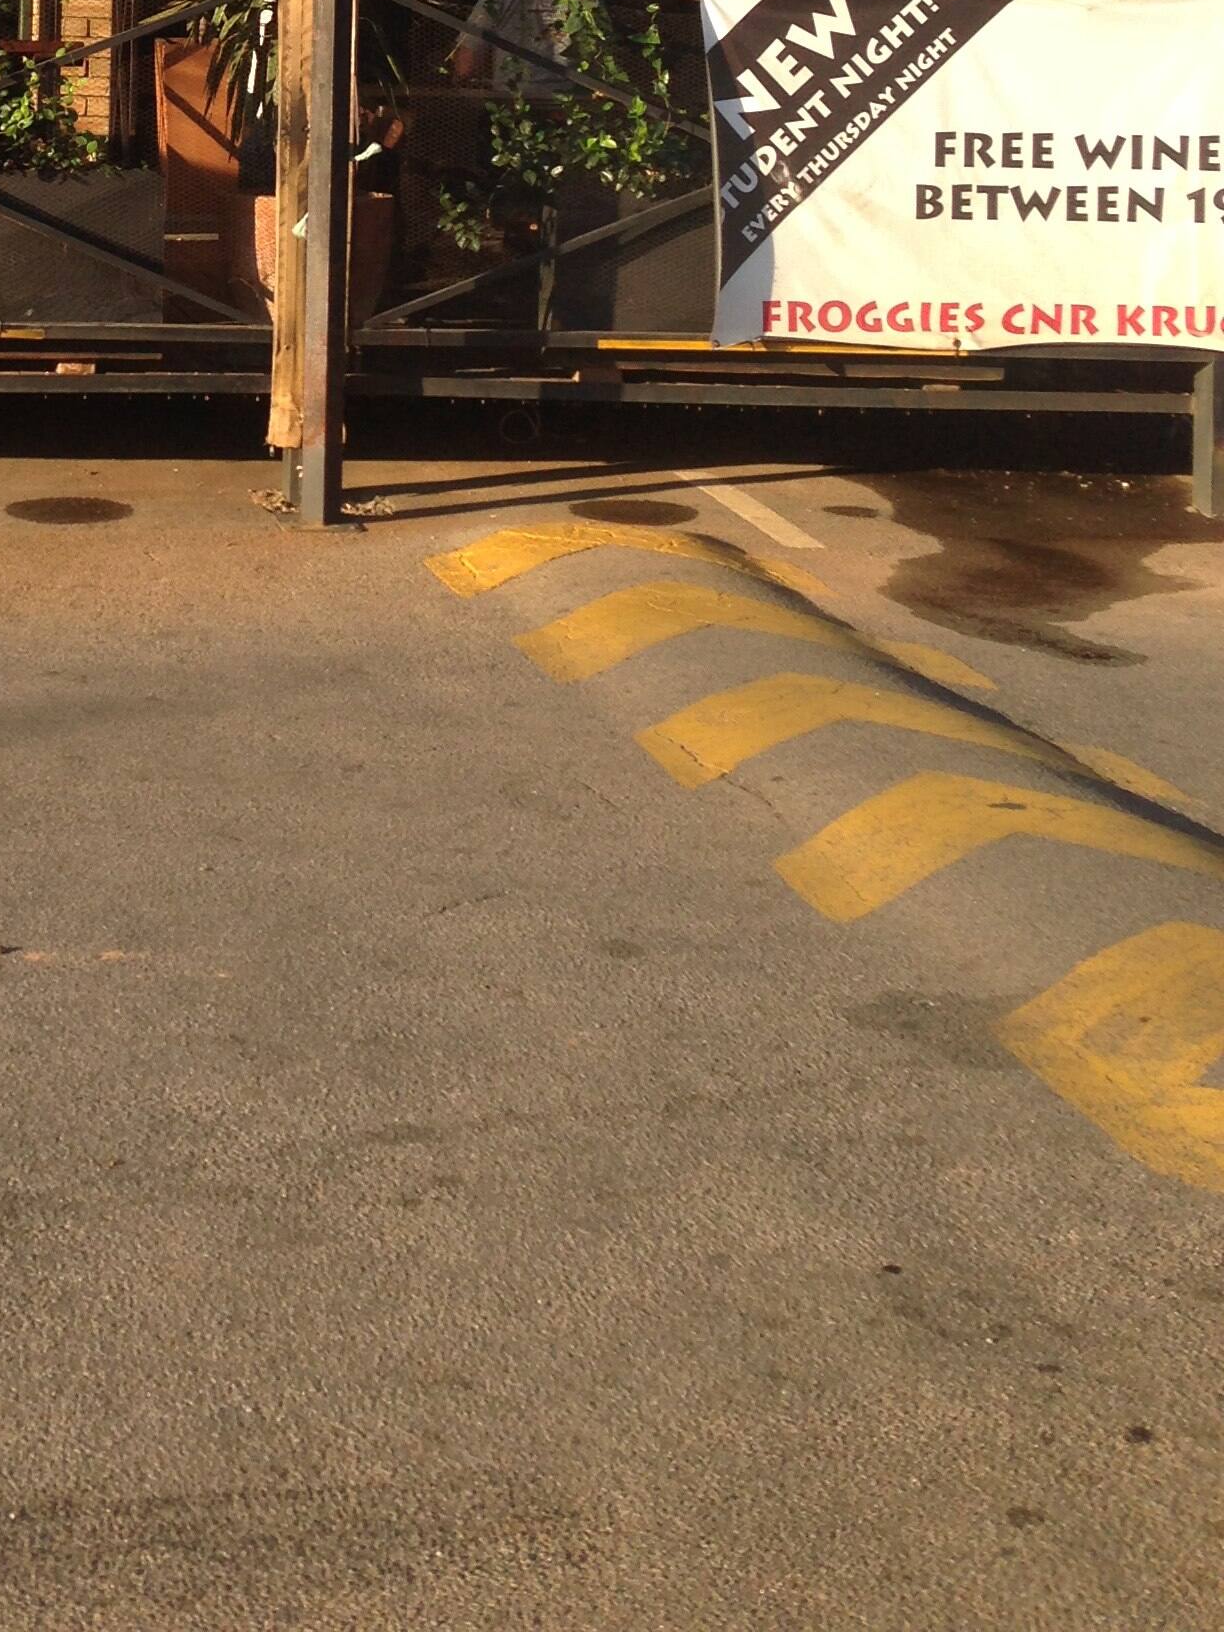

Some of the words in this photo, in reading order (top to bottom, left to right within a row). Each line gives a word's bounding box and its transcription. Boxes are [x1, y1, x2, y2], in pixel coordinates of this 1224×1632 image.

[740, 180, 801, 244] EVERY
[796, 85, 897, 186] THURSDAY
[894, 27, 958, 92] NIGHT
[934, 132, 1054, 169] FREE
[1075, 134, 1222, 172] WINE
[720, 89, 832, 226] TUDENT
[915, 184, 1165, 223] BETWEEN
[761, 300, 984, 334] FROGGIES
[1001, 303, 1100, 335] CNR
[1116, 303, 1224, 338] KRU
